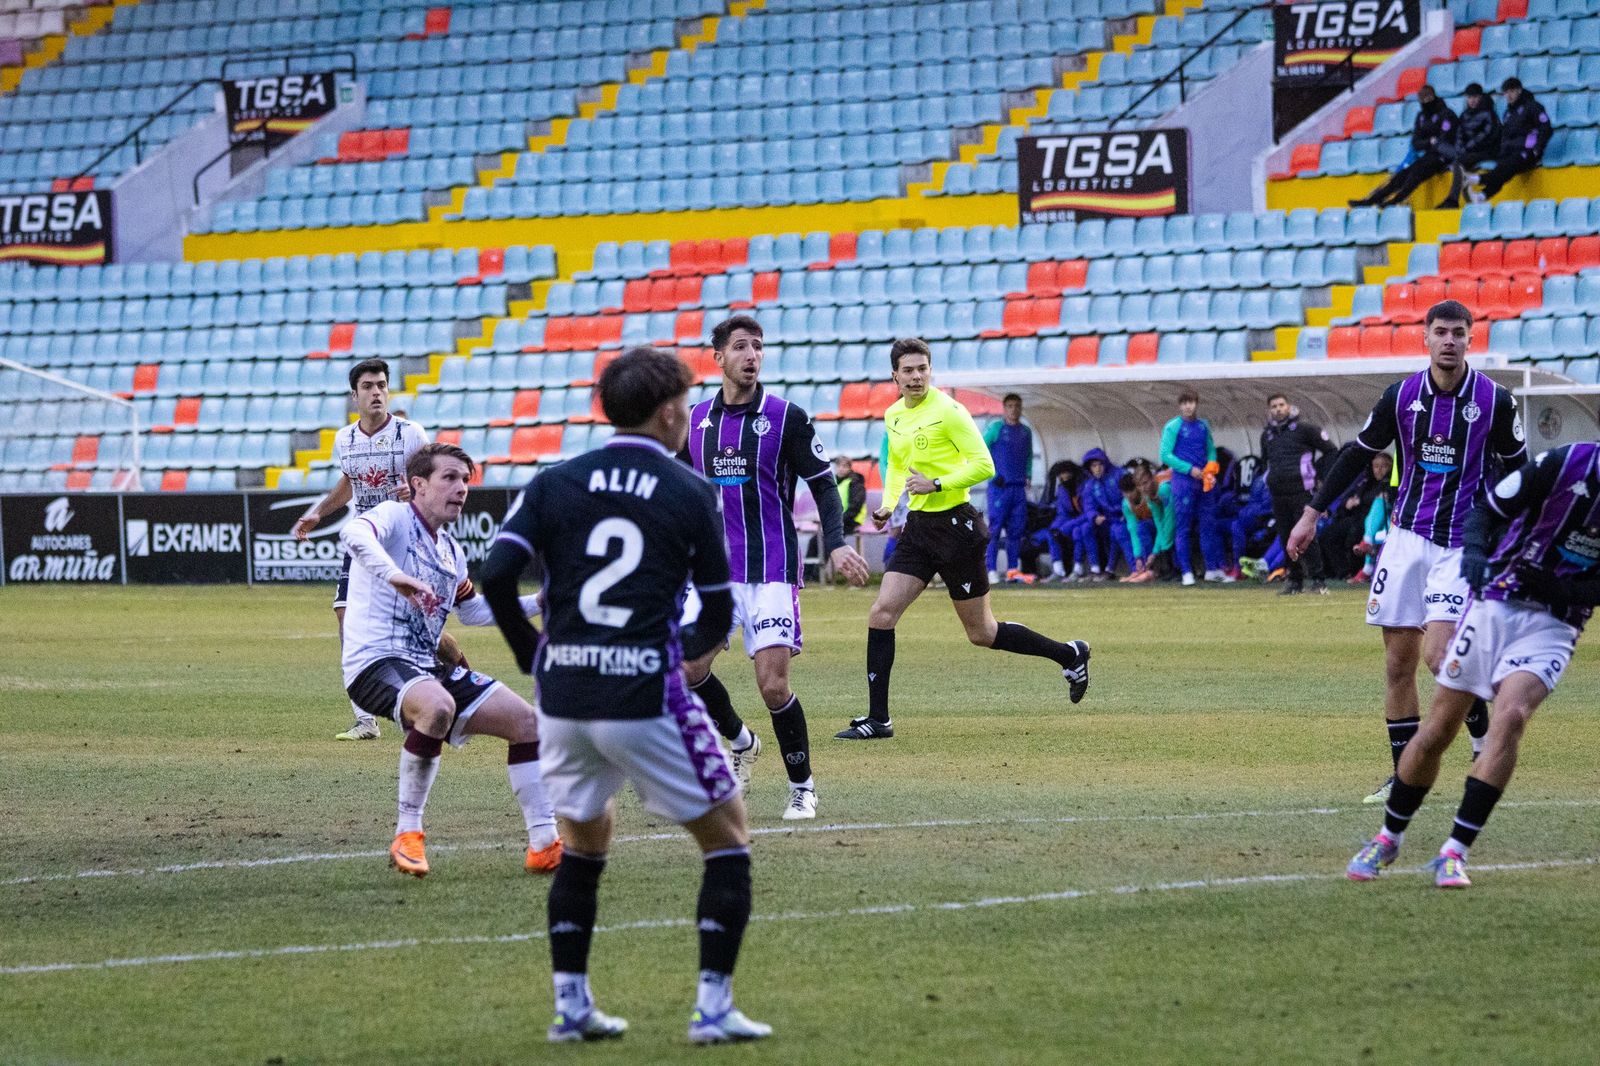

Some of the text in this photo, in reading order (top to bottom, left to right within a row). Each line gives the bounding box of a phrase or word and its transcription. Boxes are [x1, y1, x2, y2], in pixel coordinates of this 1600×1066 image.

[1290, 0, 1409, 39] TGSA
[234, 75, 327, 110] TGSA
[1036, 132, 1174, 179] TGSA
[1032, 176, 1134, 192] LOGISTICS
[0, 191, 103, 233] TGSA
[0, 230, 73, 245] OGISTICS
[1421, 442, 1456, 455] Estrella
[1421, 451, 1454, 464] Galicia
[712, 456, 747, 466] Estrella
[714, 465, 746, 476] Galicia
[588, 467, 659, 500] ALIN
[31, 534, 92, 551] AUTOCARES
[152, 522, 243, 553] EXFAMEX
[254, 567, 270, 580] DE
[578, 517, 645, 629] 2
[1373, 567, 1388, 595] 8
[1424, 593, 1464, 606] NEXO
[753, 617, 793, 635] NEXO
[1456, 625, 1476, 656] 5
